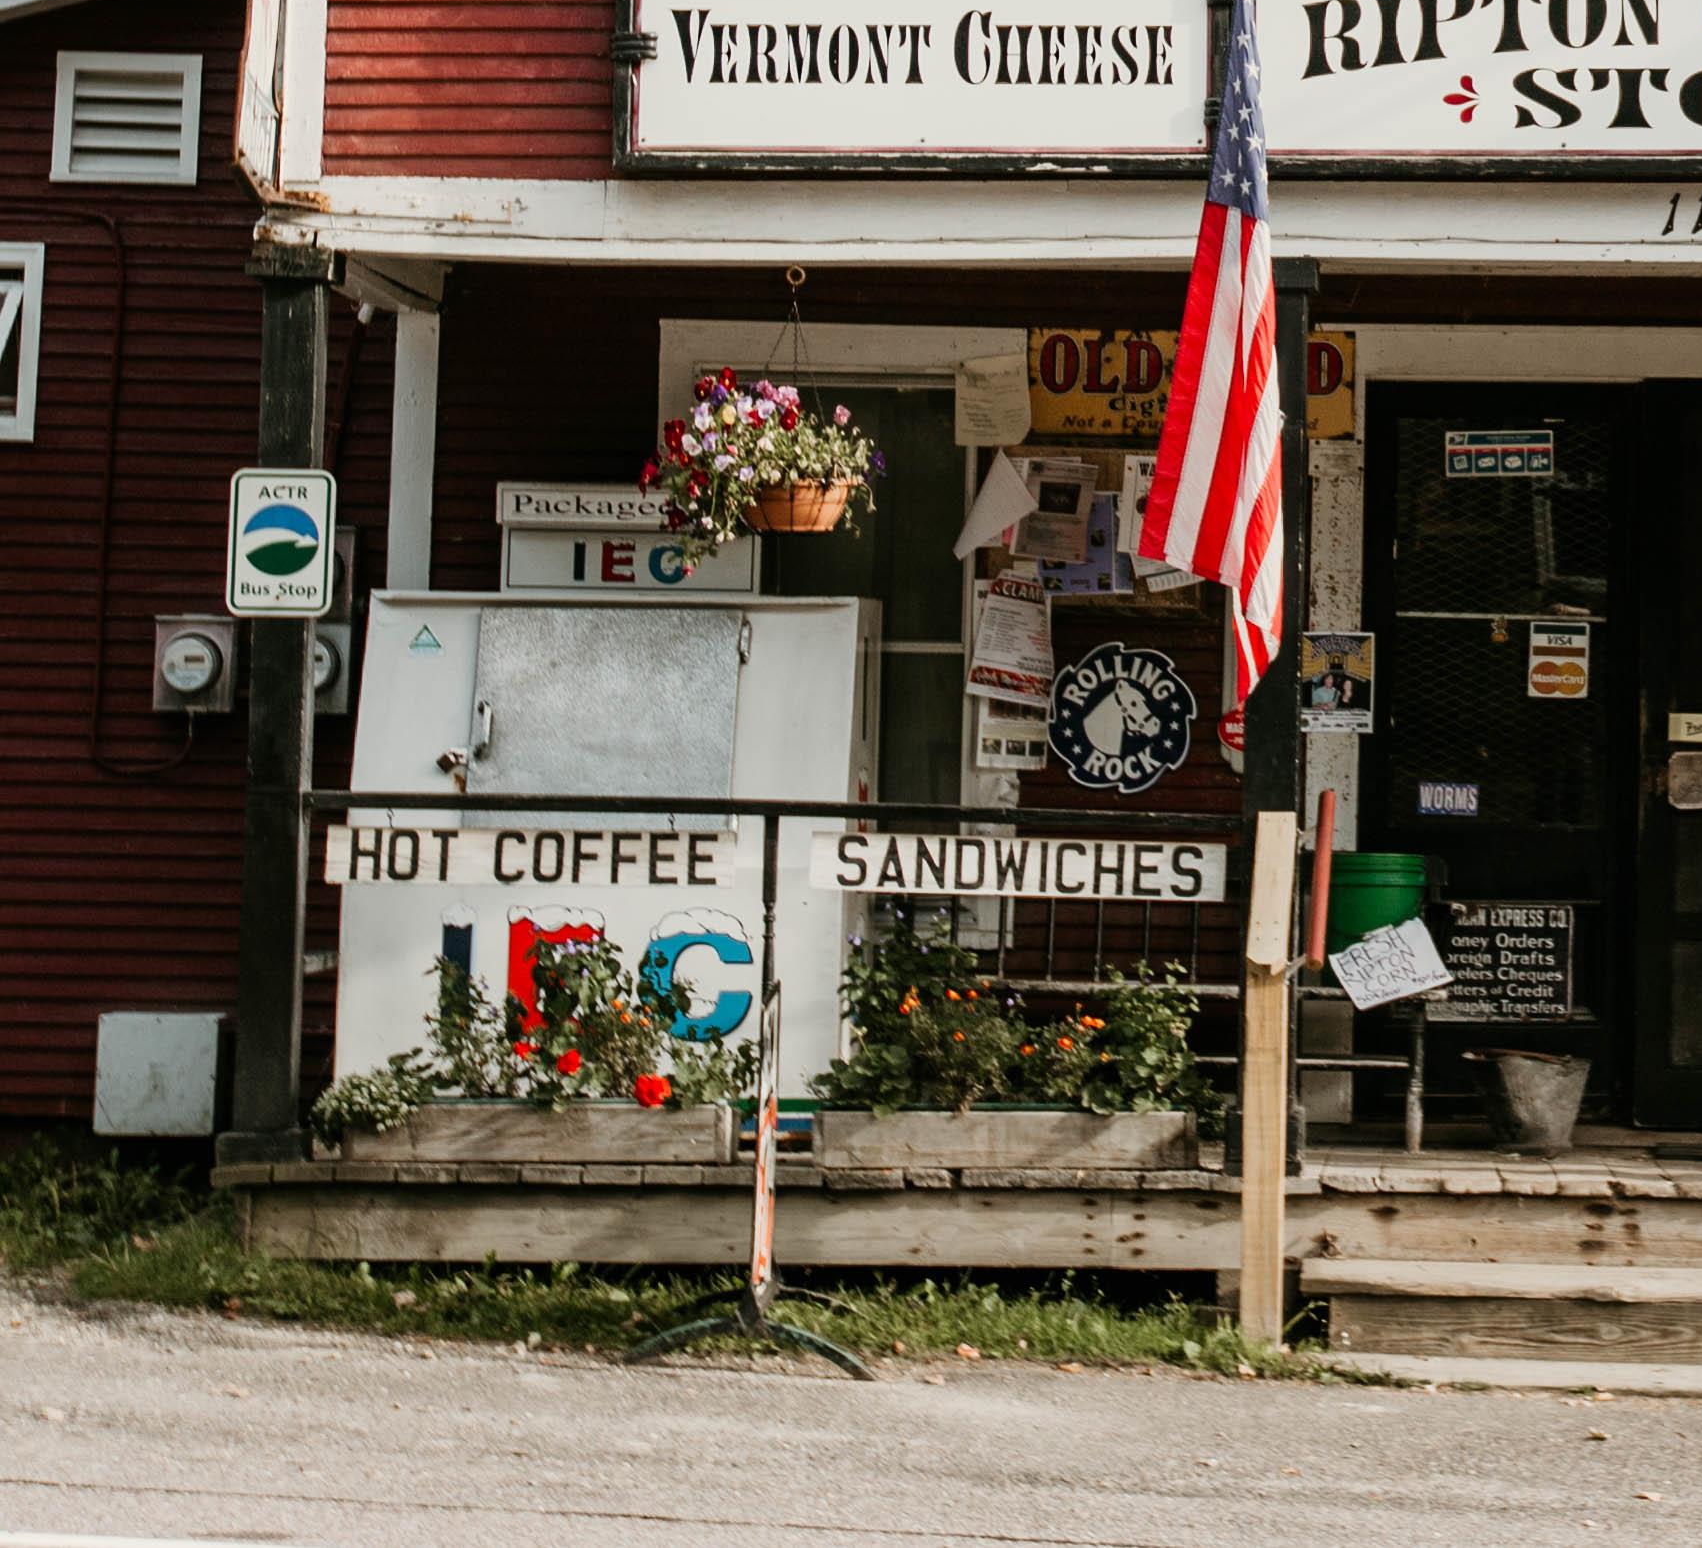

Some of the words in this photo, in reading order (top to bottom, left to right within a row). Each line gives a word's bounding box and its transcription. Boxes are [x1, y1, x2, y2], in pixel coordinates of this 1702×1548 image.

[671, 9, 932, 84] VERMONT
[953, 10, 1174, 84] CHEESE
[1039, 332, 1164, 394] OLD
[258, 485, 309, 500] ACTR
[240, 582, 271, 597] Bus
[278, 582, 318, 601] Stop
[1547, 635, 1573, 645] VISA
[1062, 655, 1176, 706] ROLLING
[1082, 746, 1162, 781] ROCK
[1419, 783, 1478, 811] WORMS
[349, 828, 458, 881] HOT
[494, 830, 718, 886] COFFEE
[836, 834, 1204, 898] SANDWICHES
[1490, 908, 1545, 928] EXPRESS
[1451, 936, 1489, 952] oney
[1495, 933, 1555, 949] Orders
[1500, 951, 1555, 966] Drafts
[1497, 967, 1563, 984] Cheques
[1446, 985, 1487, 996] etters
[1506, 984, 1554, 998] Credit
